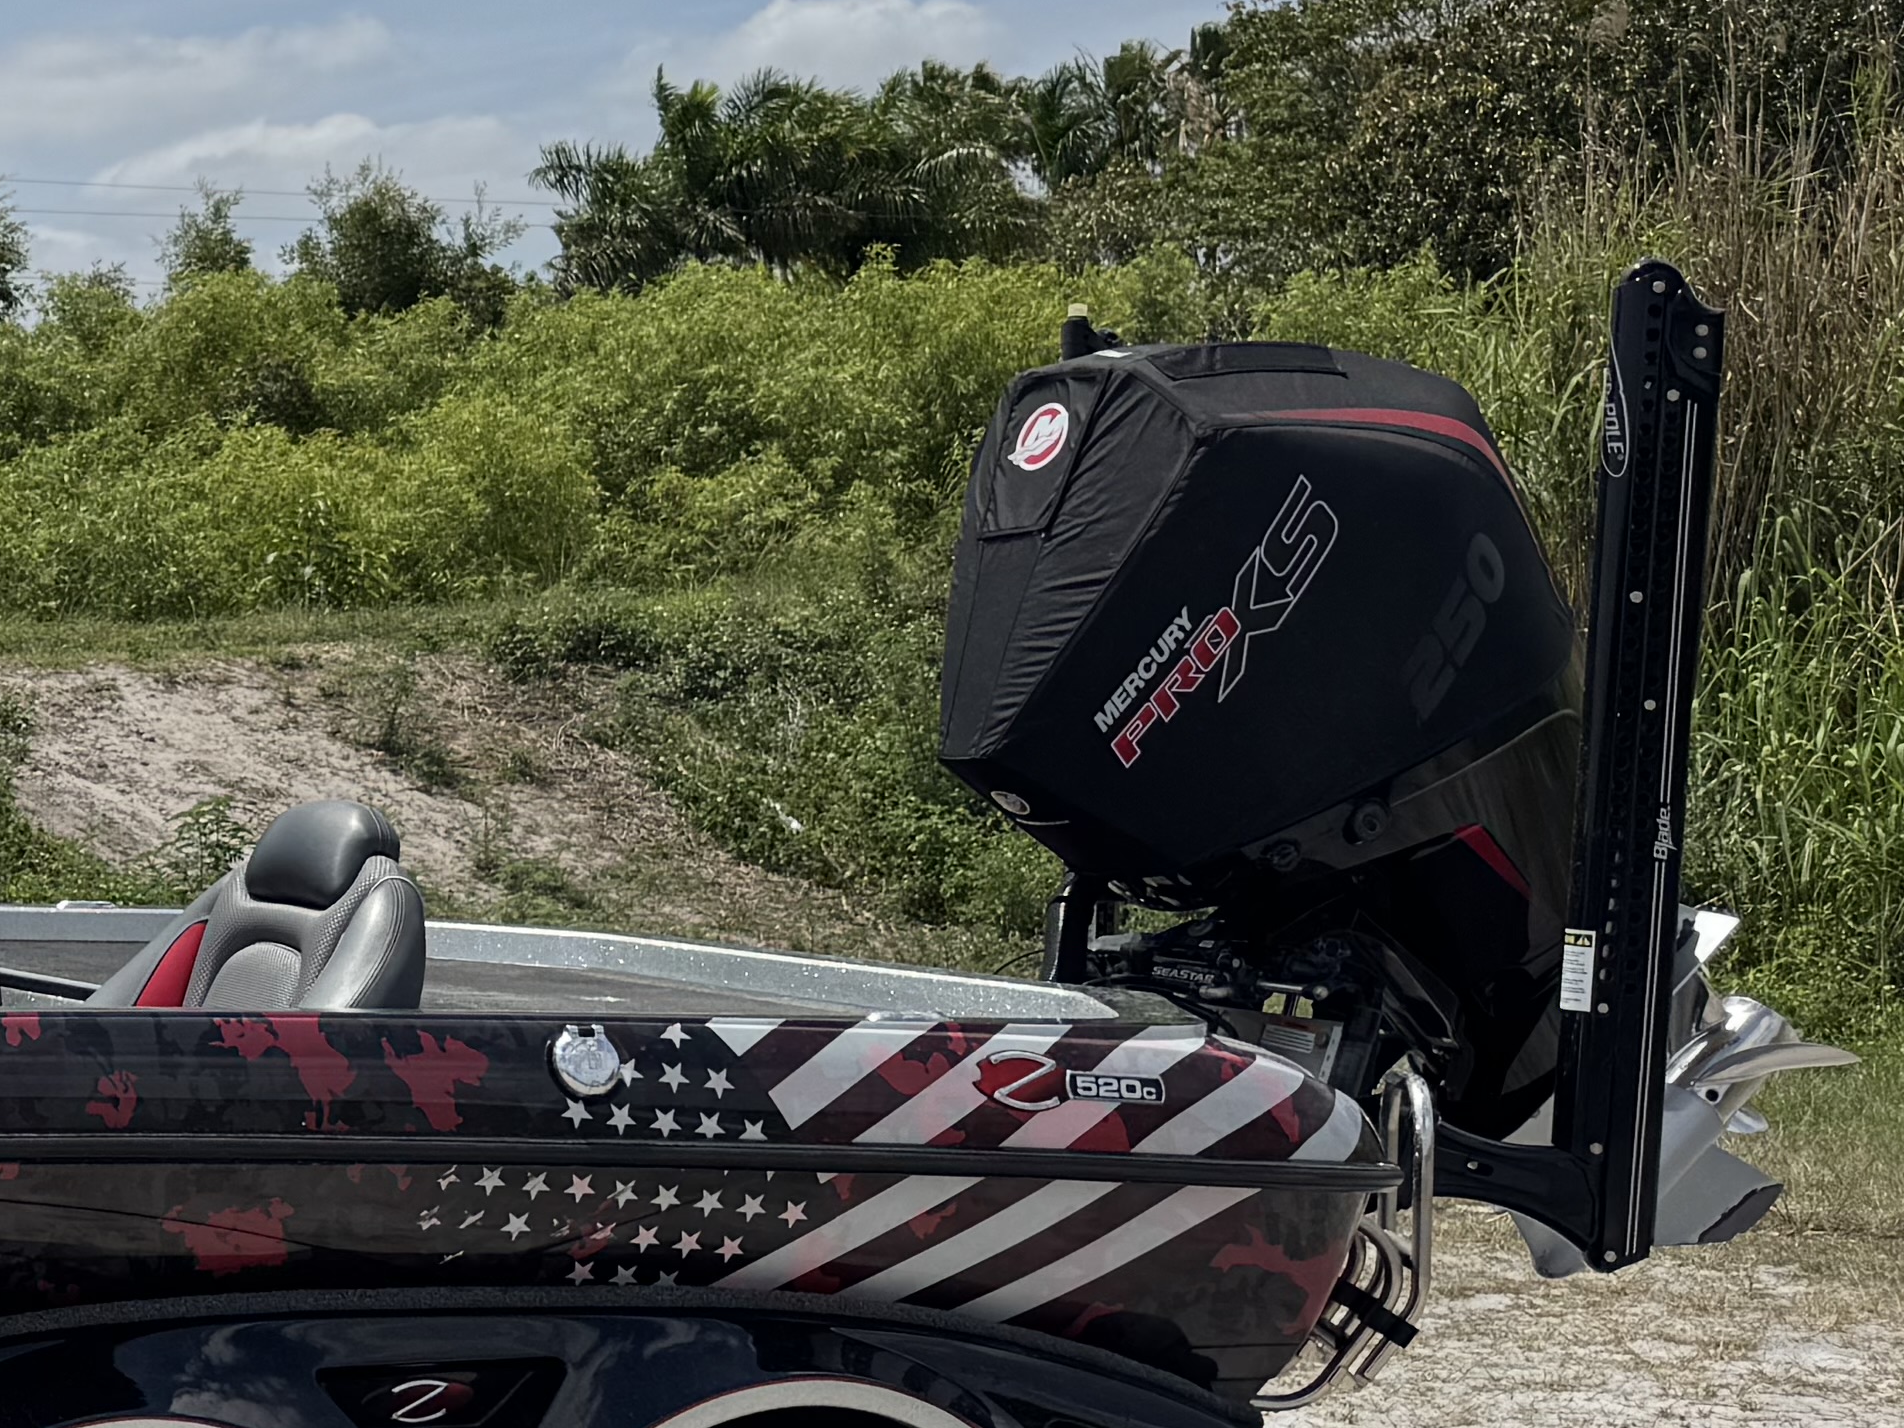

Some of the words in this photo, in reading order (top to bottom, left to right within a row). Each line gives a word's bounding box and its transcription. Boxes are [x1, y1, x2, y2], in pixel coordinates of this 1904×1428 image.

[1093, 605, 1193, 733] MERCURY
[1110, 606, 1242, 769] PRO
[1400, 531, 1505, 721] 250
[1653, 807, 1678, 860] Blade
[1151, 966, 1215, 984] SEASTAR
